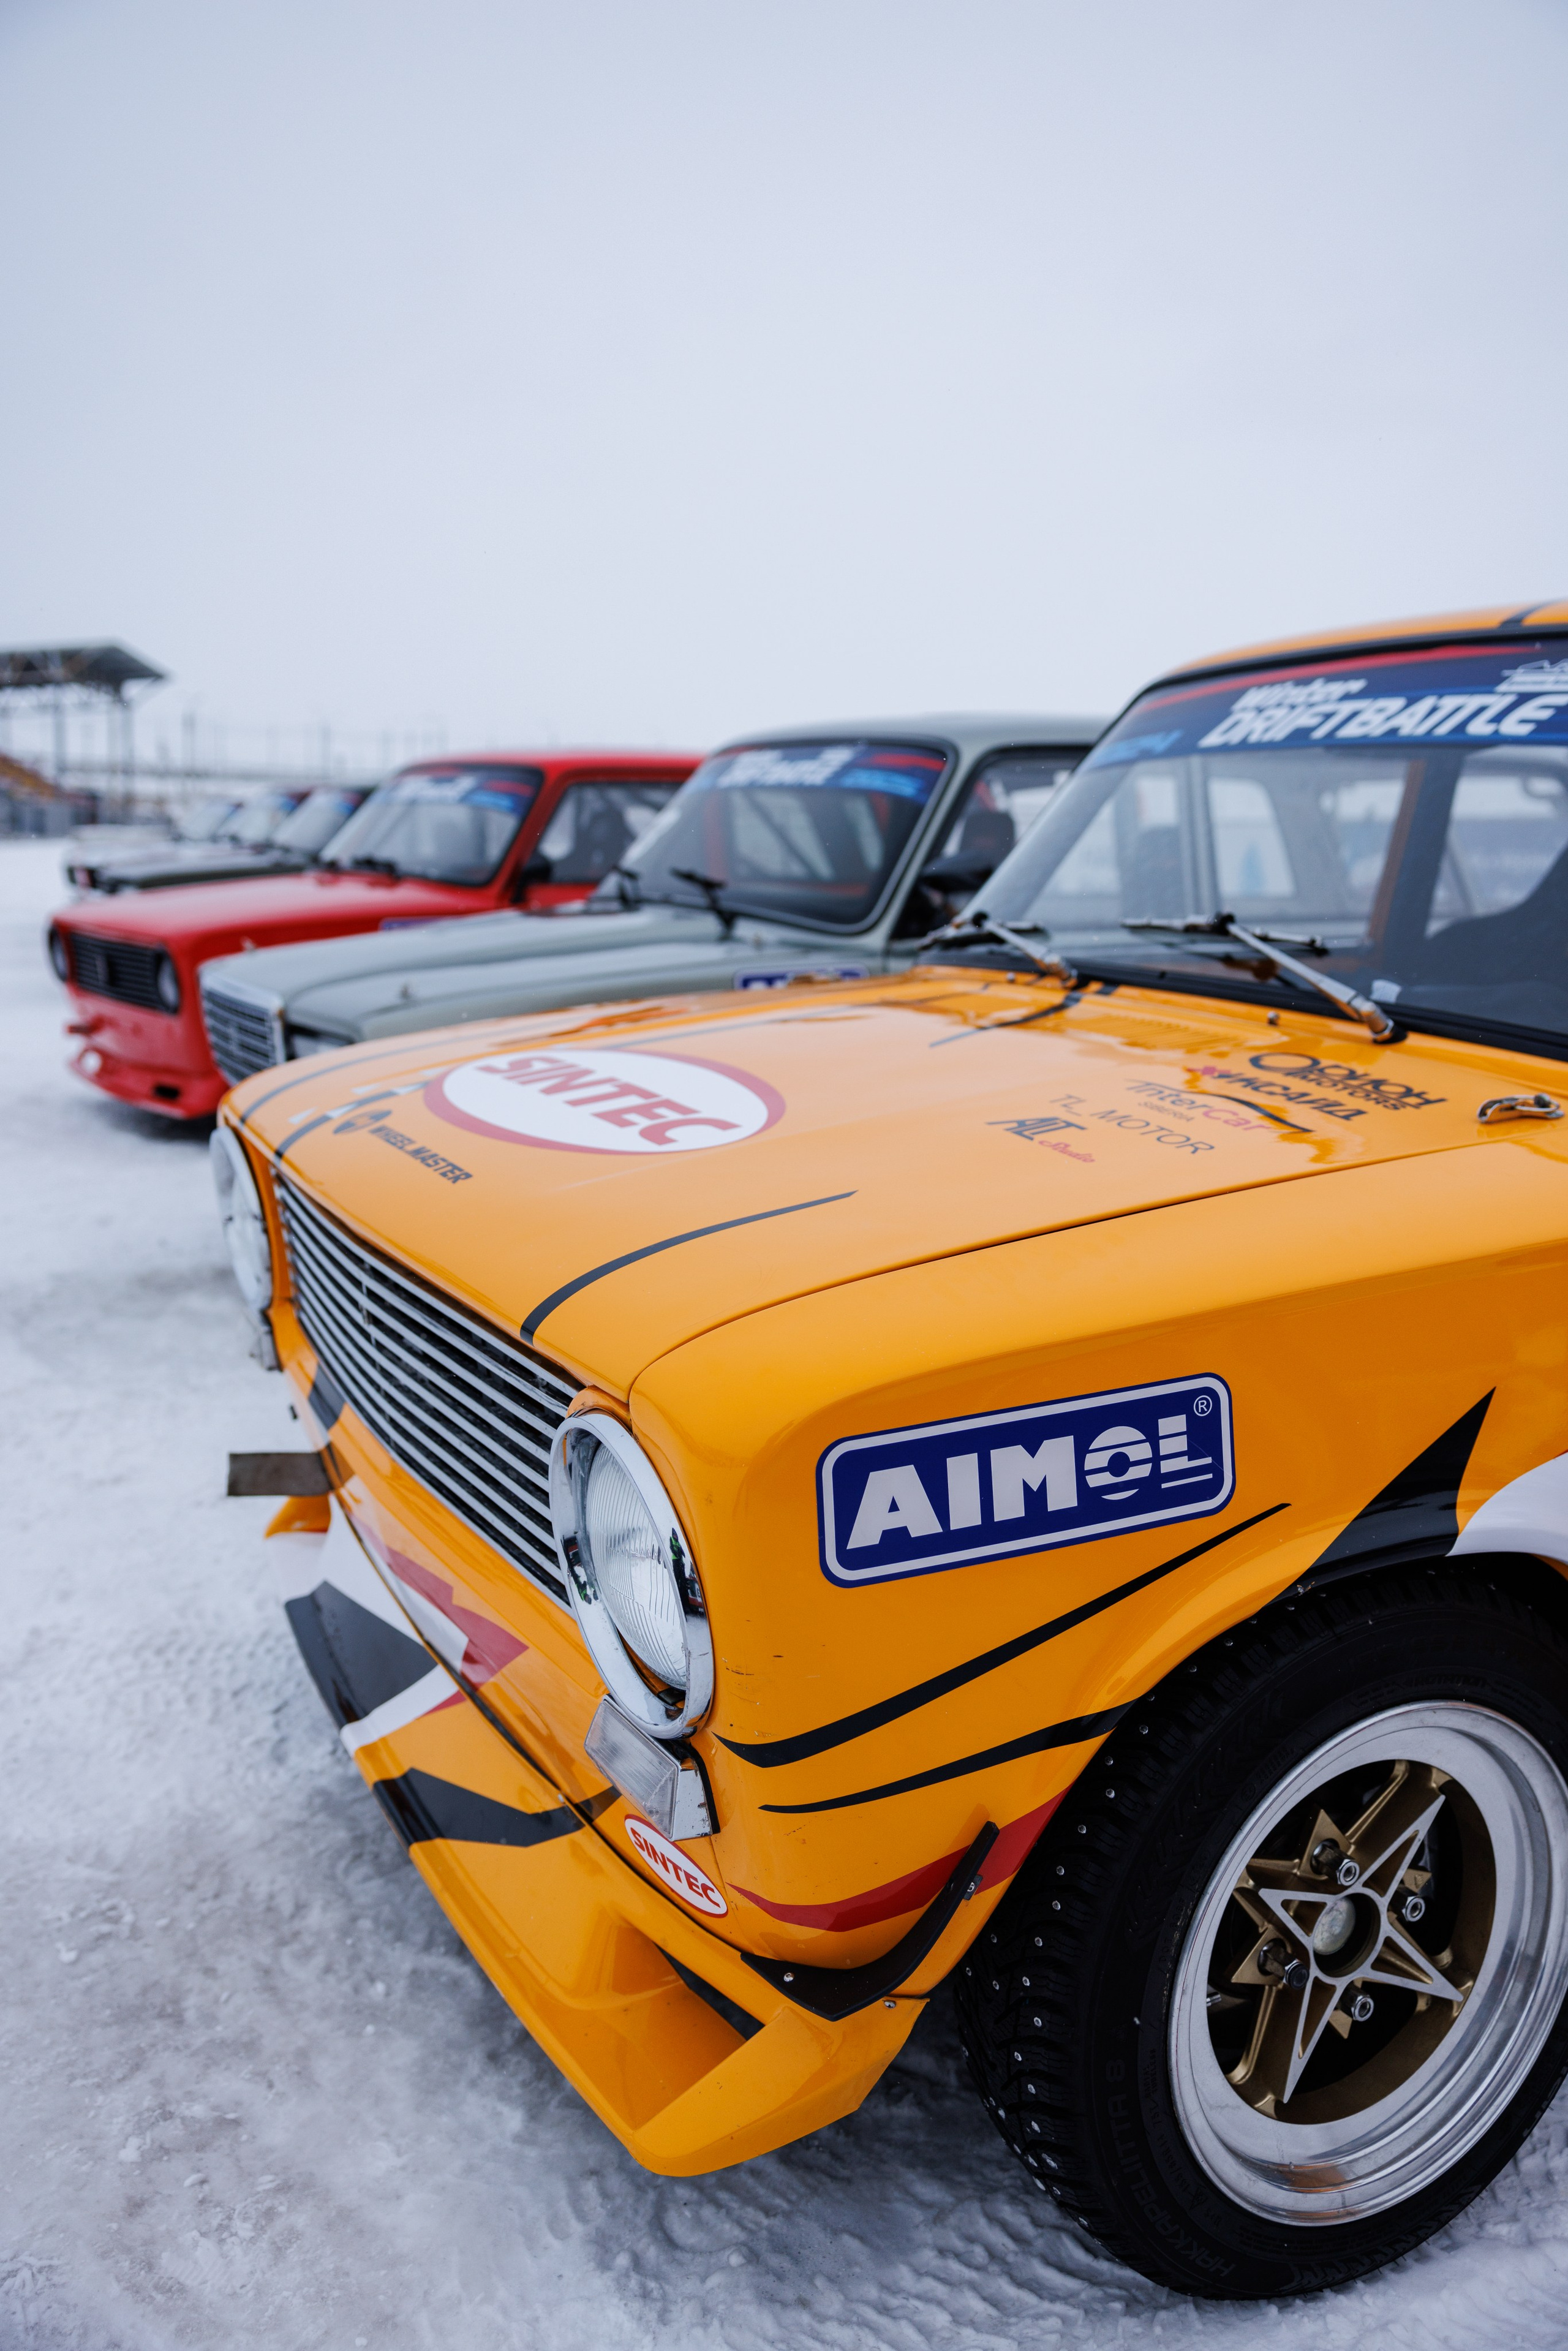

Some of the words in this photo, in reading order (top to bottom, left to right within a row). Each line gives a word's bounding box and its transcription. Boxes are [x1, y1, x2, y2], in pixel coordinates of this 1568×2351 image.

[1231, 677, 1368, 712] Winter
[475, 1055, 744, 1147] SINTEC
[630, 1827, 721, 1909] SINTEC
[1105, 2058, 1126, 2084] 8
